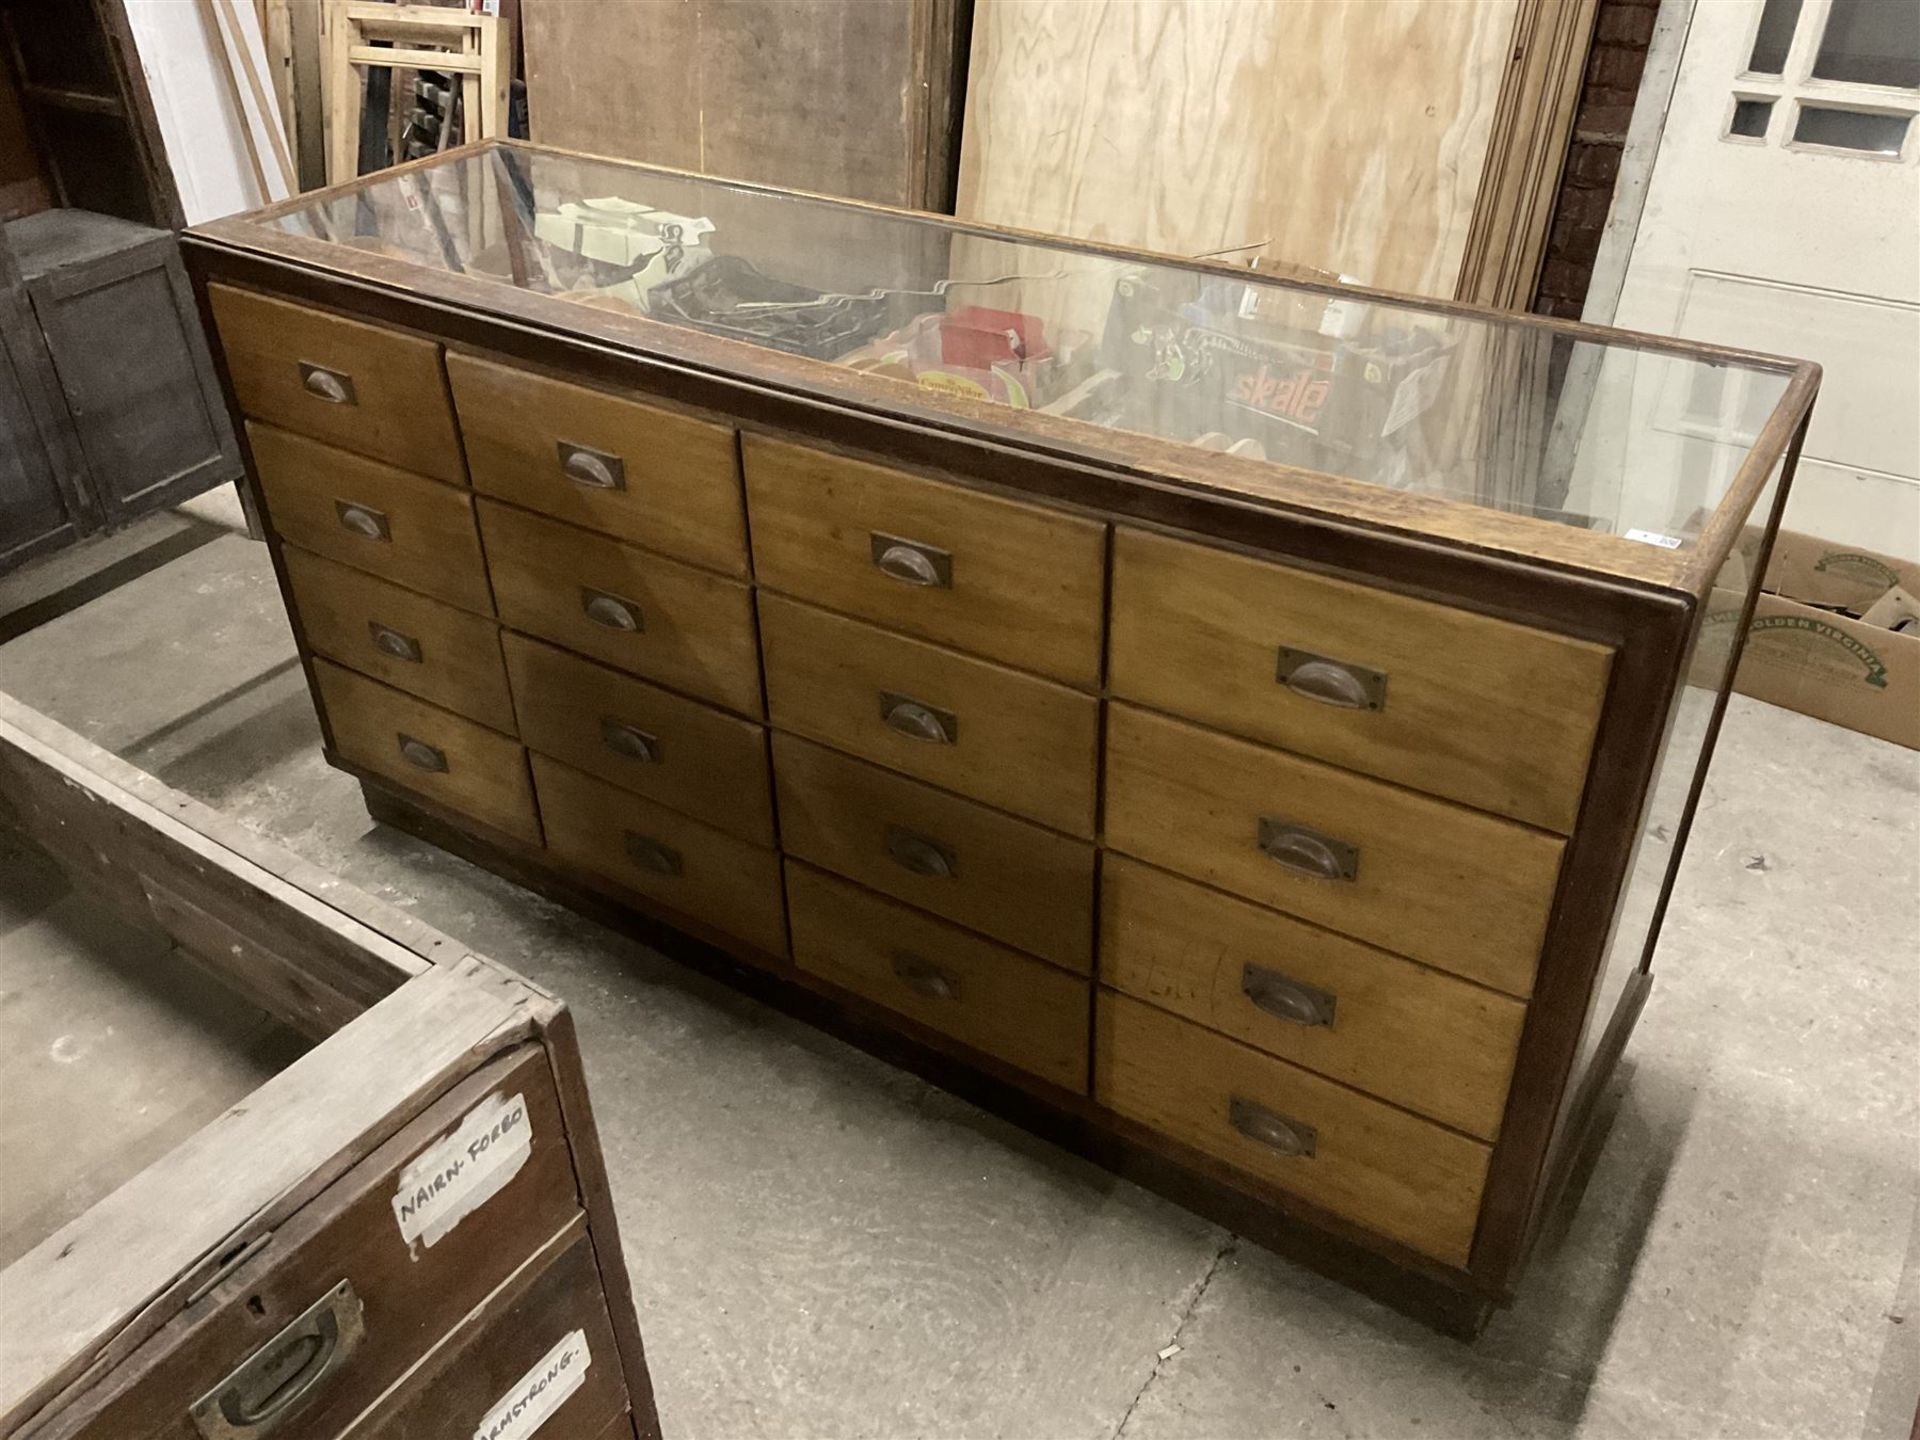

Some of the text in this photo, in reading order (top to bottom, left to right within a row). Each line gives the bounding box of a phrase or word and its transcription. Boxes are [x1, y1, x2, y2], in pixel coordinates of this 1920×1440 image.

[1748, 616, 1811, 631] OLDEN
[1815, 624, 1883, 674] VIRGINIA
[467, 1108, 524, 1161] FORBO
